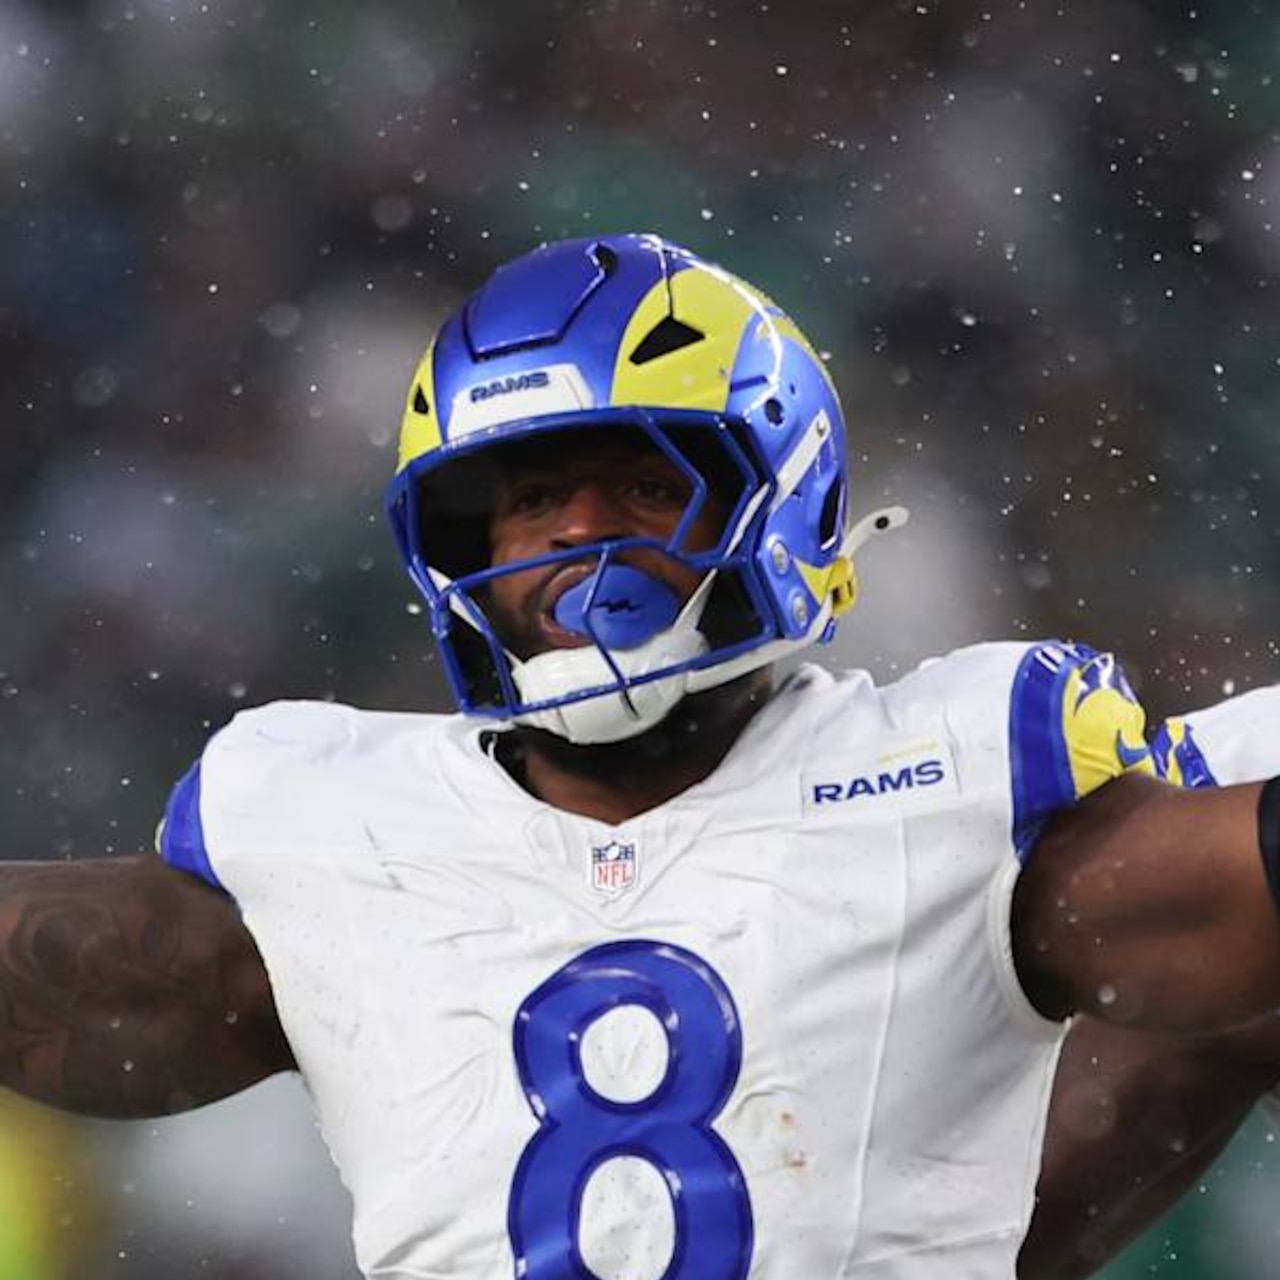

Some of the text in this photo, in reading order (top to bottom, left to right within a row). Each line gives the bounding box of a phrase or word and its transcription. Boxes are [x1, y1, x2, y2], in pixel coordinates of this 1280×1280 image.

[471, 372, 549, 402] RAMS
[813, 760, 945, 804] RAMS
[597, 863, 633, 887] NFL
